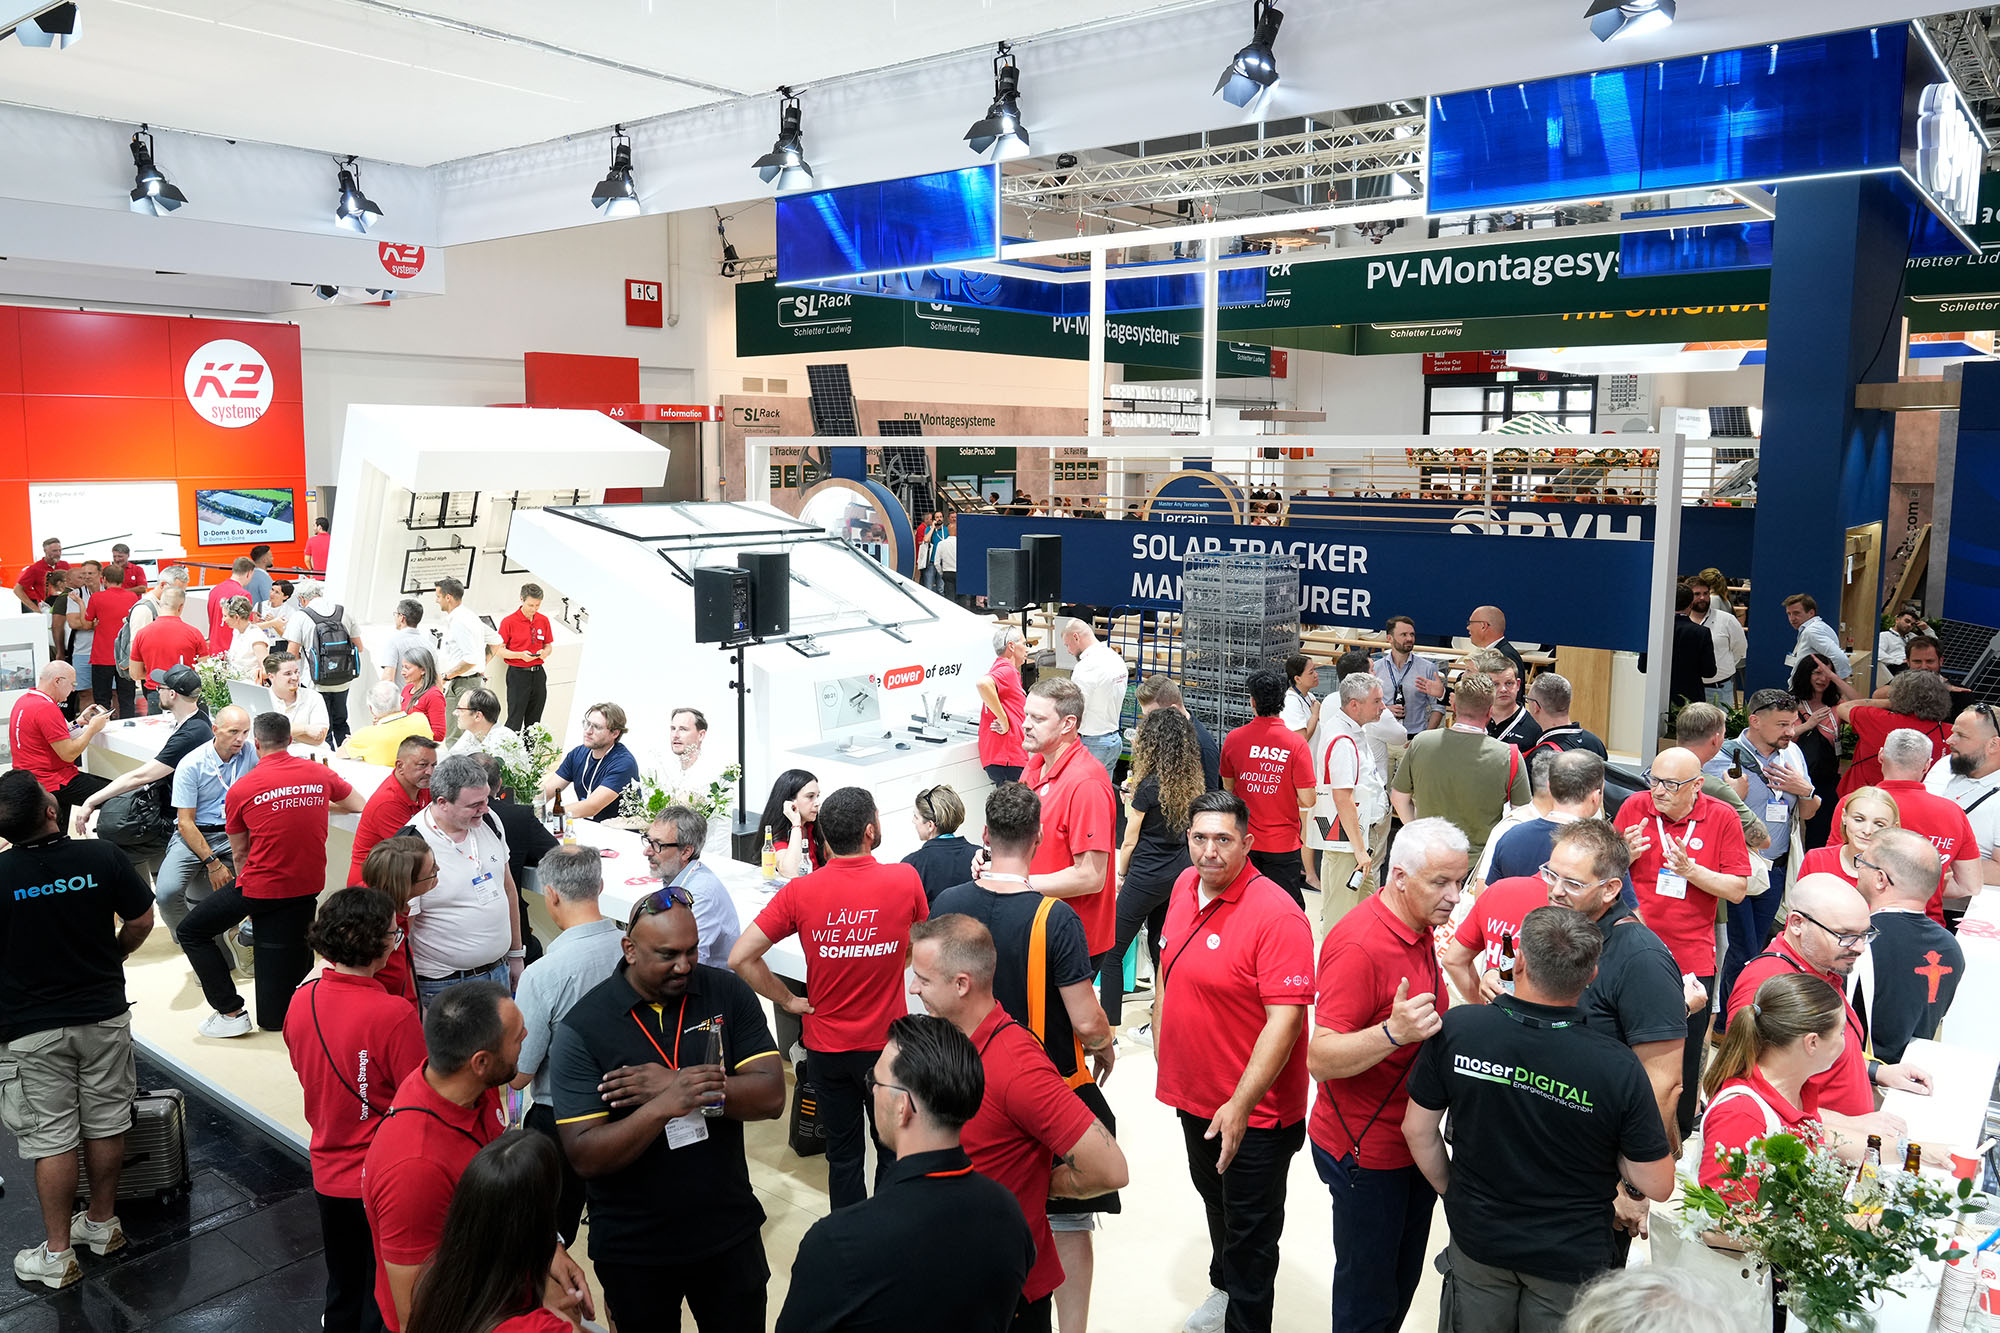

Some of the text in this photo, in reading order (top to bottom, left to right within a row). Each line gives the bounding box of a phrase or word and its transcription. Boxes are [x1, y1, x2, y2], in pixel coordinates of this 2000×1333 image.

[383, 243, 419, 263] K2
[1906, 252, 2000, 268] hletter Lud
[392, 265, 419, 276] systems
[1367, 251, 1620, 289] PV-Montagesy
[818, 294, 852, 309] Rack
[1939, 302, 1999, 312] Schletter
[793, 324, 852, 337] Schletter Ludwig
[930, 321, 980, 336] Schletter Ludwig
[1053, 316, 1180, 346] PV-Mtagesysteme
[1390, 328, 1462, 338] Schletter Ludwig
[1237, 354, 1266, 364] Schletter Ludwig
[193, 362, 264, 399] K2
[211, 404, 262, 421] systems
[609, 408, 624, 416] A6
[660, 408, 702, 418] Information
[744, 408, 780, 422] SL Rack
[774, 447, 800, 456] Tracker
[959, 448, 996, 456] Solar.Pro.Tool
[1158, 512, 1208, 524] Terrain
[1132, 534, 1222, 562] SOLAR
[1131, 572, 1371, 618] MAURER
[887, 670, 921, 689] power
[926, 664, 936, 678] of
[938, 662, 962, 676] easy
[1249, 745, 1291, 763] BASE
[1260, 762, 1285, 774] YOUR
[254, 784, 324, 806] CONNECTING
[1247, 783, 1278, 794] ON US!
[271, 796, 324, 812] STRENGTH
[1929, 836, 1956, 850] THE
[14, 874, 98, 900] neaSOL
[826, 908, 880, 926] LÄUFT
[811, 926, 878, 943] WIE AUF
[1487, 917, 1520, 940] WHA
[818, 940, 900, 960] SCHIENEN!
[357, 1049, 368, 1082] Strength
[1512, 1081, 1593, 1114] Energietechnik GmbH
